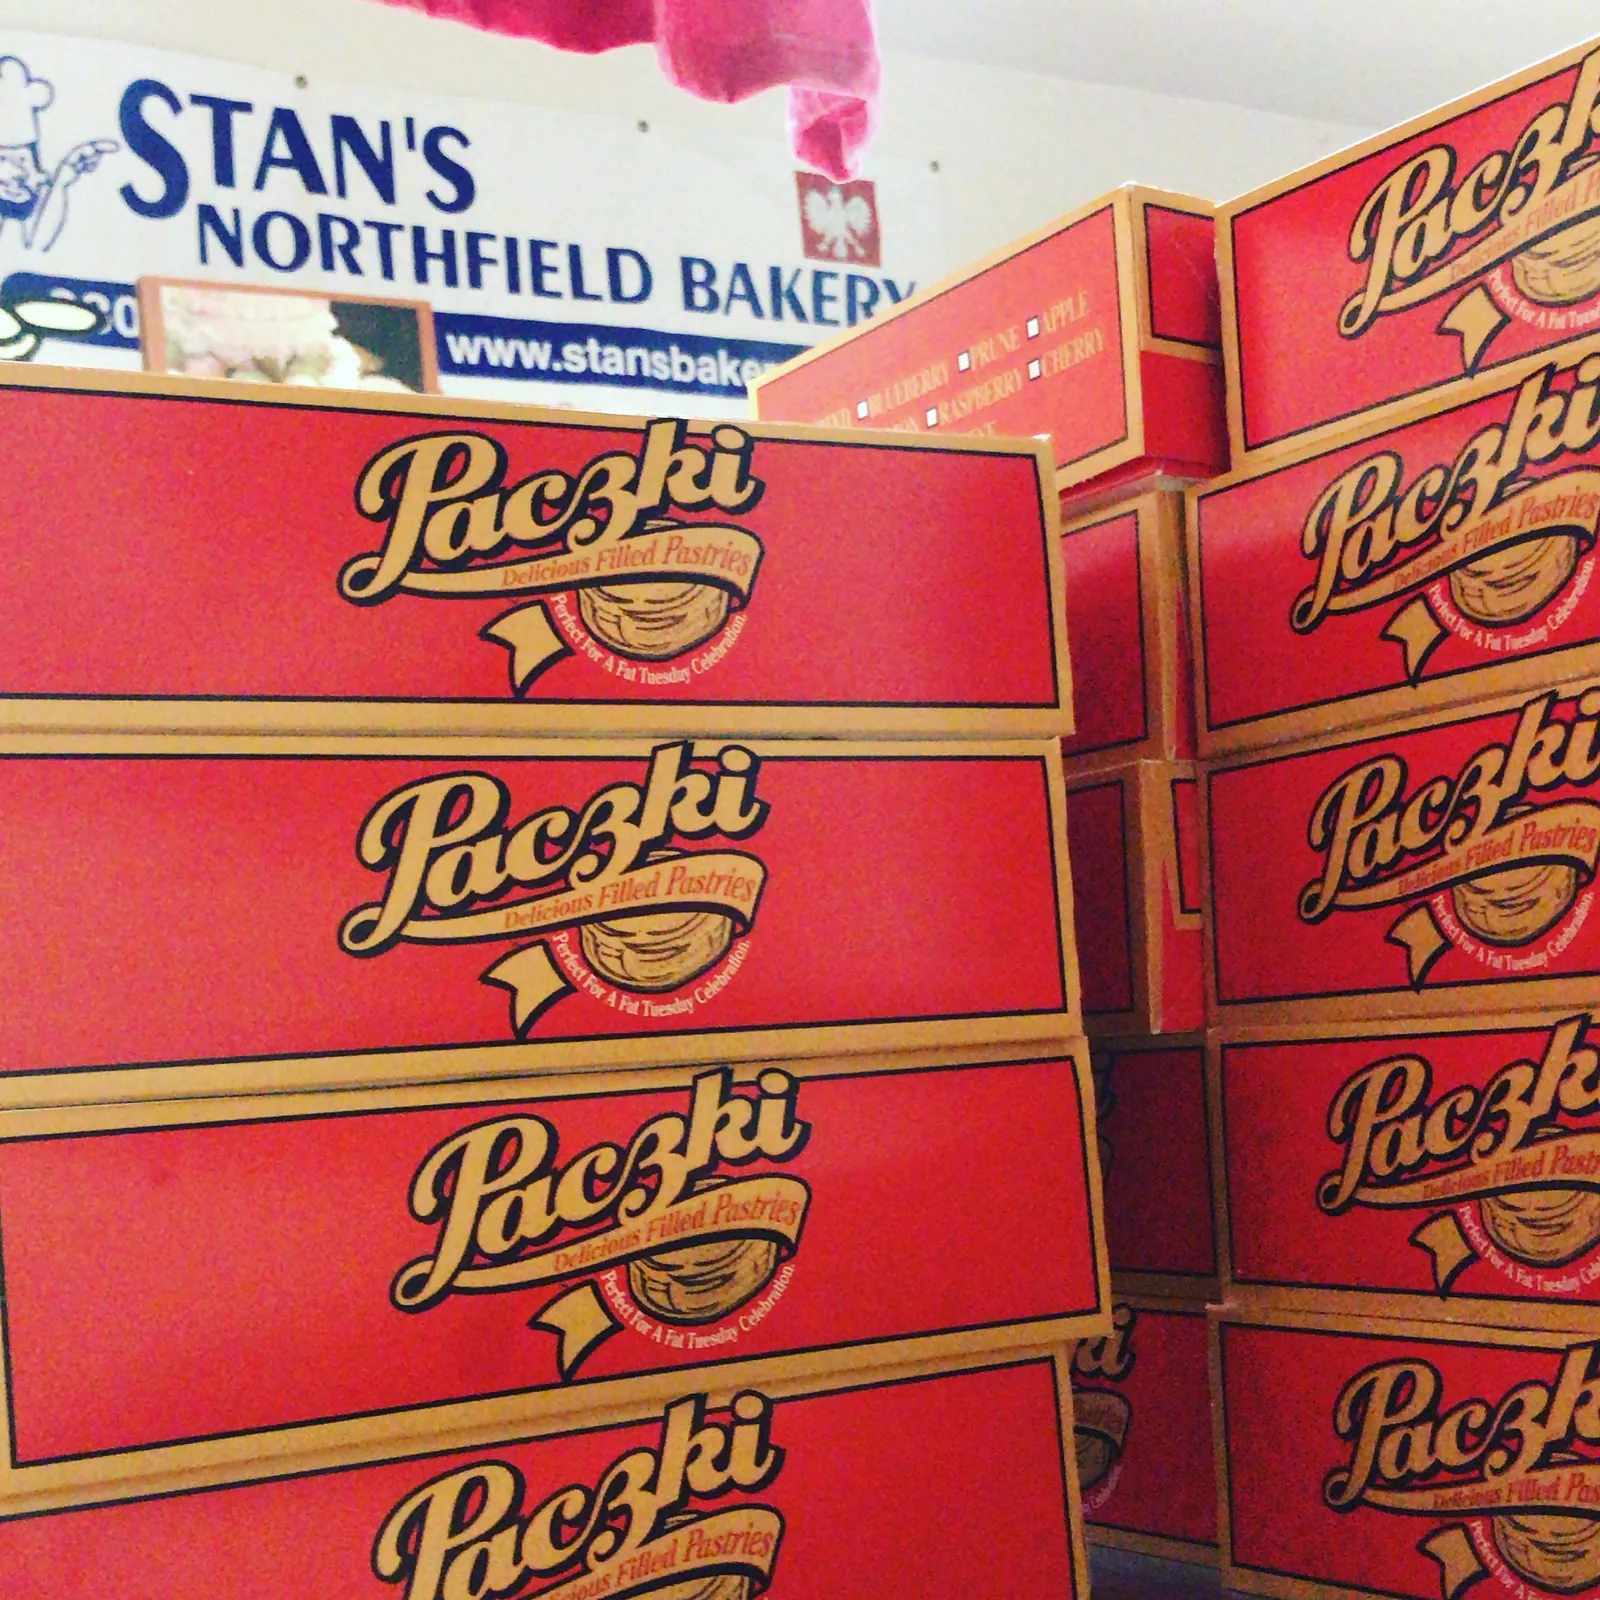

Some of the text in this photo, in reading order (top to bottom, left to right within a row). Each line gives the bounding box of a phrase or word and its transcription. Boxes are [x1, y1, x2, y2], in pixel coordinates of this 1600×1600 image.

[118, 77, 476, 219] STAN'S
[197, 204, 654, 304] NORTHFIELD
[969, 325, 1021, 373] PRUNE
[1043, 290, 1090, 334] APPLE
[1536, 311, 1546, 329] A
[938, 328, 1104, 427] RASPBERRY CHERRY
[336, 418, 765, 607] Paczki
[1290, 352, 1600, 634] Paczki
[502, 536, 751, 586] Delicious Filled Pastries
[551, 593, 585, 644] Perfect
[580, 639, 604, 662] For
[603, 656, 614, 673] A
[616, 660, 636, 682] Fat
[638, 666, 692, 684] Tuesday
[338, 739, 770, 958] Paczki
[1297, 686, 1600, 925] Paczki
[504, 865, 756, 929] Delicious Filled Pastries
[553, 932, 587, 982] Perfect
[582, 975, 607, 999] For
[604, 992, 616, 1008] A
[618, 995, 639, 1016] Fat
[641, 997, 696, 1017] Tuesday
[389, 1066, 812, 1314] Paczki
[553, 1191, 798, 1272] Delicious Filled Pastries
[601, 1270, 634, 1315] Perfect
[628, 1313, 652, 1335] For
[650, 1325, 663, 1343] A
[664, 1329, 685, 1349] Fat
[687, 1327, 738, 1349] Tuesday
[370, 1388, 786, 1600] Paczki
[616, 1538, 678, 1587] Filled
[683, 1522, 774, 1563] Pastries
